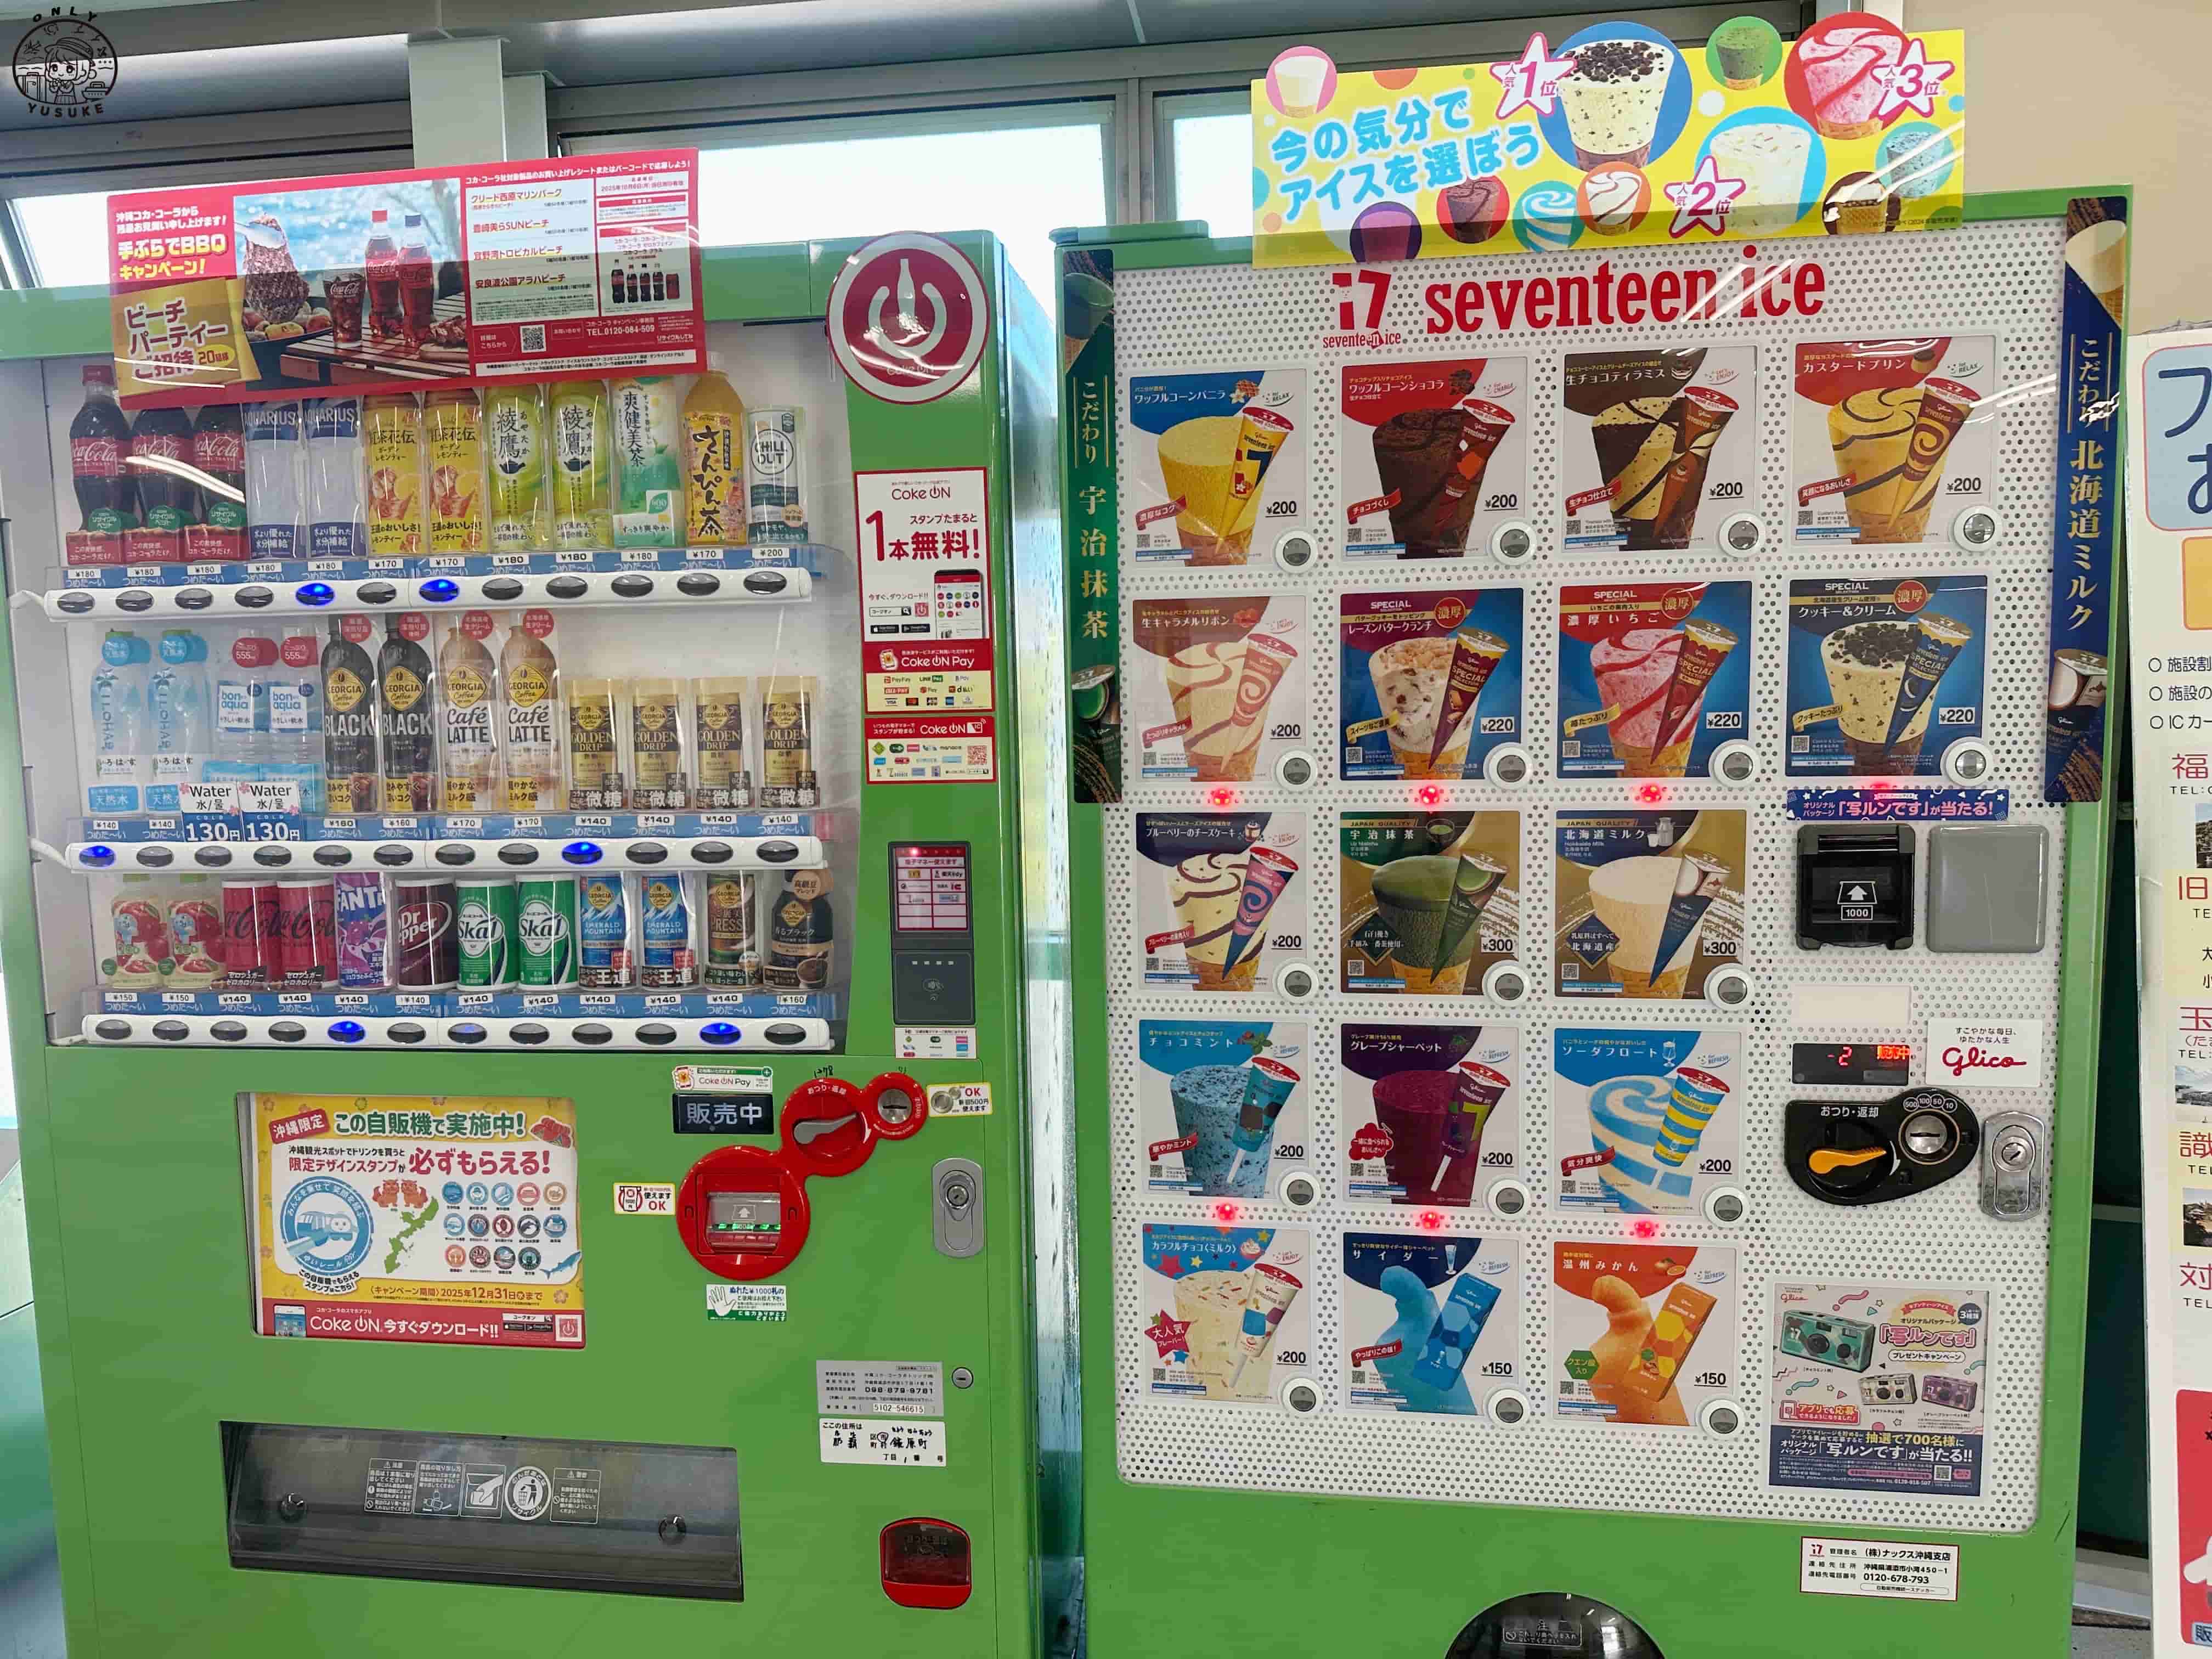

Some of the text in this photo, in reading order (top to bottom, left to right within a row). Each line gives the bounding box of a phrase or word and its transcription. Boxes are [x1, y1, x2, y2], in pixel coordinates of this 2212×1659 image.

[1271, 90, 1470, 172] 今の気分で
[1279, 125, 1539, 223] アイスを選ぼう
[118, 234, 226, 259] 手ぶらでBBQ
[1425, 244, 1825, 334] seventeen ice
[127, 300, 184, 328] ビーチ
[130, 324, 225, 354] パーティー
[1385, 329, 1401, 345] ice
[136, 350, 193, 378] ご招待
[1803, 359, 1906, 373] カスタードプリン
[1566, 369, 1666, 386] 生チョコティラミス
[1349, 380, 1444, 393] ワッフルコーンショコラ
[1134, 390, 1226, 404] ワッフルコーンバニラ
[498, 408, 522, 459] 綾鷹
[624, 391, 645, 467] 爽健美茶
[755, 442, 786, 453] CHILL
[758, 454, 785, 464] OUT
[693, 425, 724, 538] さんぴん茶
[1947, 477, 1981, 492] ¥200
[892, 486, 950, 500] Coke ON
[1709, 482, 1743, 496] ¥200
[1266, 501, 1297, 515] ¥200
[1352, 499, 1389, 515] チョコづくし
[1485, 494, 1517, 509] ¥200
[1079, 381, 1108, 639] こだわり 宇治抹茶
[910, 514, 977, 524] スタンプたまると
[2067, 439, 2104, 631] 北海道ミルク
[1594, 590, 1637, 599] SPECIAL
[1898, 590, 1923, 603] 濃厚
[1371, 601, 1411, 609] SPECIAL
[1664, 598, 1689, 610] 濃厚
[1799, 606, 1896, 618] クッキー&クリーム
[1142, 617, 1229, 628] 生キャラメルリボン
[1567, 613, 1660, 626] 濃厚いちご
[1349, 621, 1431, 634] レーズンバタークランチ
[901, 657, 974, 668] Coke ON Pay
[448, 703, 487, 725] Café
[509, 706, 549, 723] Café
[1708, 714, 1740, 727] ¥220
[1940, 709, 1973, 723] ¥220
[921, 725, 947, 734] Coke
[950, 723, 966, 733] ON
[1271, 724, 1301, 737] ¥200
[1482, 719, 1513, 732] ¥220
[448, 726, 489, 743] LATTE
[509, 725, 551, 742] LATTE
[2172, 754, 2208, 779] 福
[190, 785, 232, 797] Water
[250, 784, 292, 797] Water
[96, 794, 128, 805] 天然水
[588, 791, 622, 807] 微糖
[186, 823, 240, 842] 130円
[246, 822, 300, 841] 130円
[1146, 828, 1235, 838] ブルーベリーのチーズケーキ
[1351, 830, 1414, 840] 宇治抹茶
[1565, 829, 1645, 840] 北海道ミルク
[2178, 876, 2208, 900] 旧
[1846, 909, 1868, 917] 1000
[1272, 935, 1301, 947] ¥200
[1482, 939, 1513, 951] ¥300
[1704, 942, 1736, 955] ¥300
[1149, 1038, 1233, 1048] チョコミント
[1959, 1036, 2011, 1044] ゆたかな人生
[1351, 1042, 1441, 1052] グレープシャーベット
[1562, 1048, 1658, 1057] ソーダフロート
[1942, 1047, 2027, 1076] Glico
[699, 1077, 719, 1086] Coke
[735, 1078, 751, 1087] Pay
[965, 1088, 981, 1097] OK
[1905, 1101, 1917, 1109] 500
[1920, 1097, 1930, 1105] 100
[687, 1103, 762, 1125] 販売中
[1821, 1107, 1878, 1118] おつり・返却
[273, 1114, 325, 1138] 沖縄限定
[1274, 1146, 1304, 1157] ¥200
[289, 1157, 405, 1173] 限定デザインスタンプが
[1482, 1153, 1513, 1165] ¥200
[649, 1200, 666, 1211] OK
[1353, 1251, 1439, 1261] サイダー
[1562, 1259, 1638, 1272] 温州みかん
[311, 1317, 352, 1331] Coke
[355, 1316, 380, 1333] ON
[1153, 1324, 1184, 1339] 大人気
[1880, 1324, 1976, 1347] 「写ルンです」
[1482, 1363, 1512, 1374] ¥150
[1694, 1373, 1726, 1385] ¥150
[1866, 1432, 1965, 1447] 抽選で700名様に
[1864, 1573, 1929, 1583] 0120-678-793
